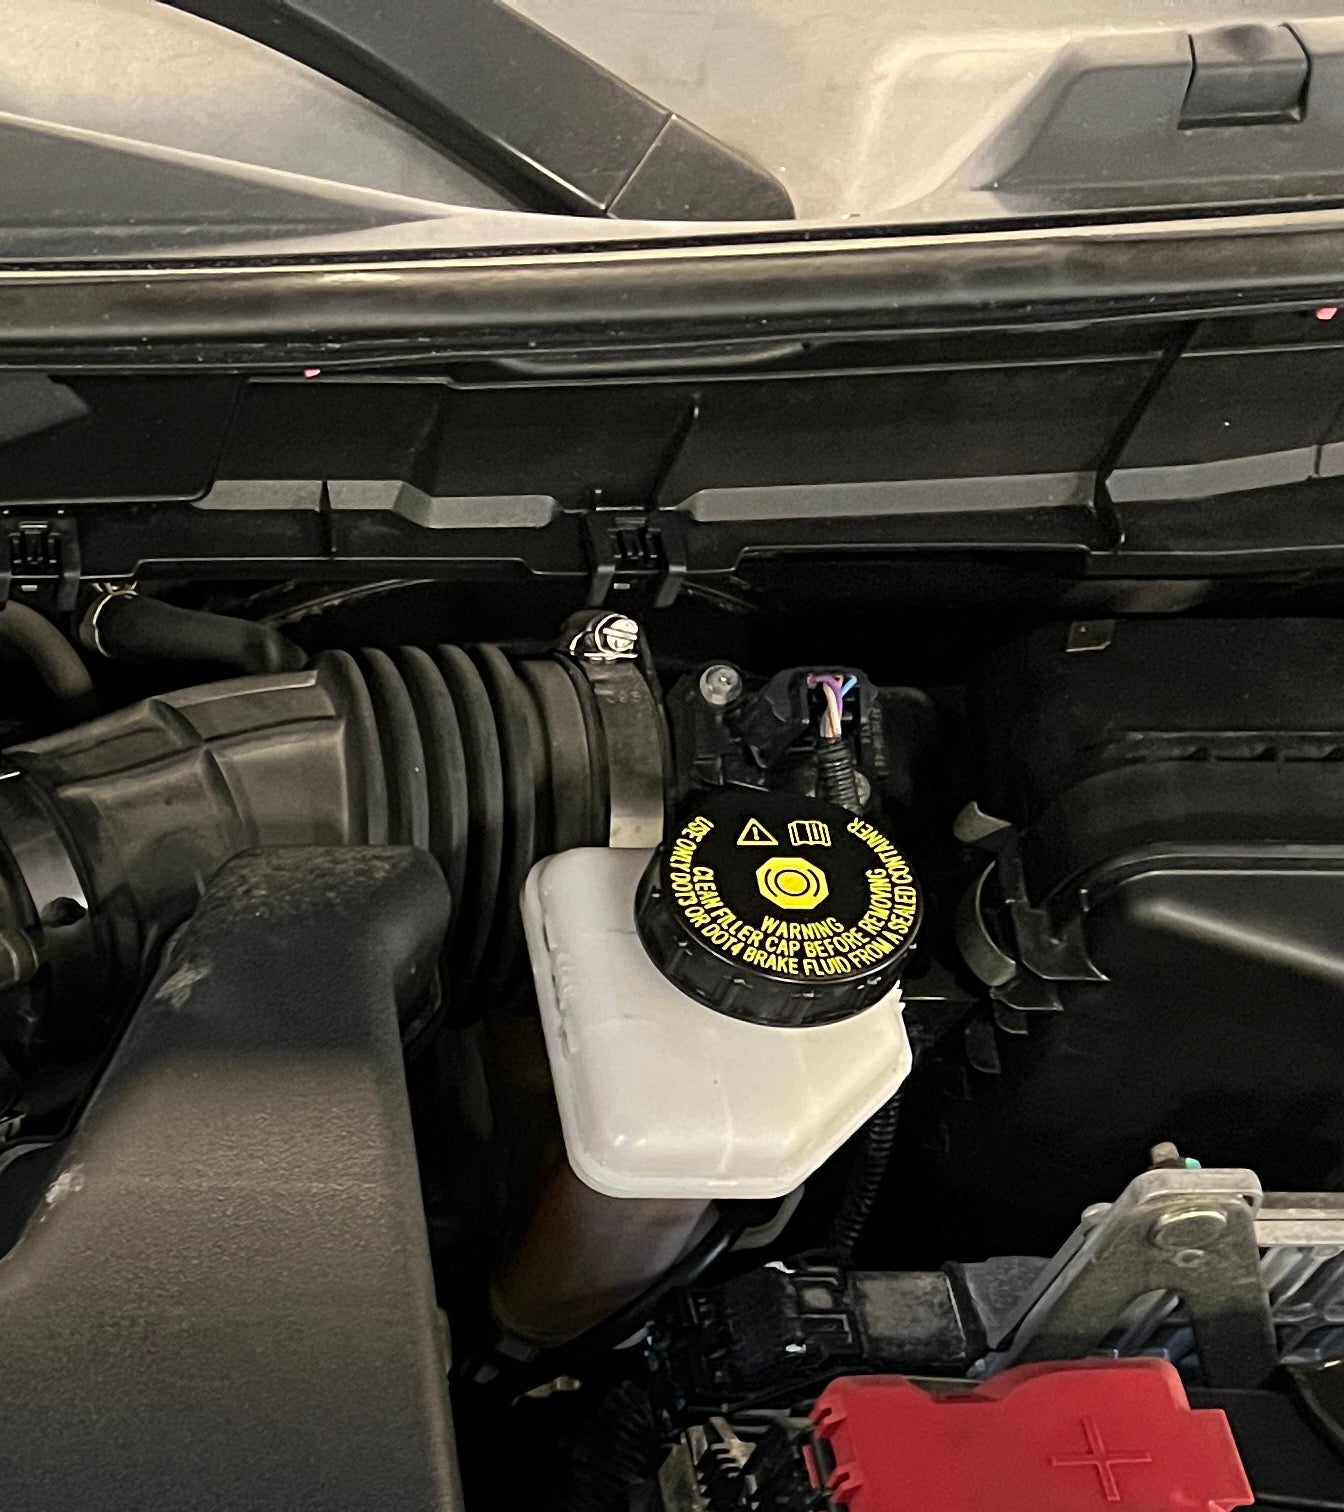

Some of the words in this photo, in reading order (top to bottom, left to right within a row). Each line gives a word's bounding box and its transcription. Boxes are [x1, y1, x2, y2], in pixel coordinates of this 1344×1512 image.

[681, 816, 715, 842] USE
[669, 838, 697, 872] ONLY
[846, 817, 913, 884] CONTAINER
[670, 872, 698, 907] DOT3
[684, 906, 711, 928] OR
[692, 866, 724, 910] CLEAN
[710, 907, 764, 947] FILLER
[765, 936, 801, 957] CAP
[803, 927, 870, 957] BEFORE
[858, 868, 892, 935] REMOVING
[888, 886, 916, 934] SEALED
[701, 923, 745, 956] DOT4
[761, 915, 844, 940] WARNING
[881, 930, 904, 945] A
[743, 946, 799, 975] BRAKE
[803, 956, 851, 976] FLUID
[848, 936, 895, 968] FROM
